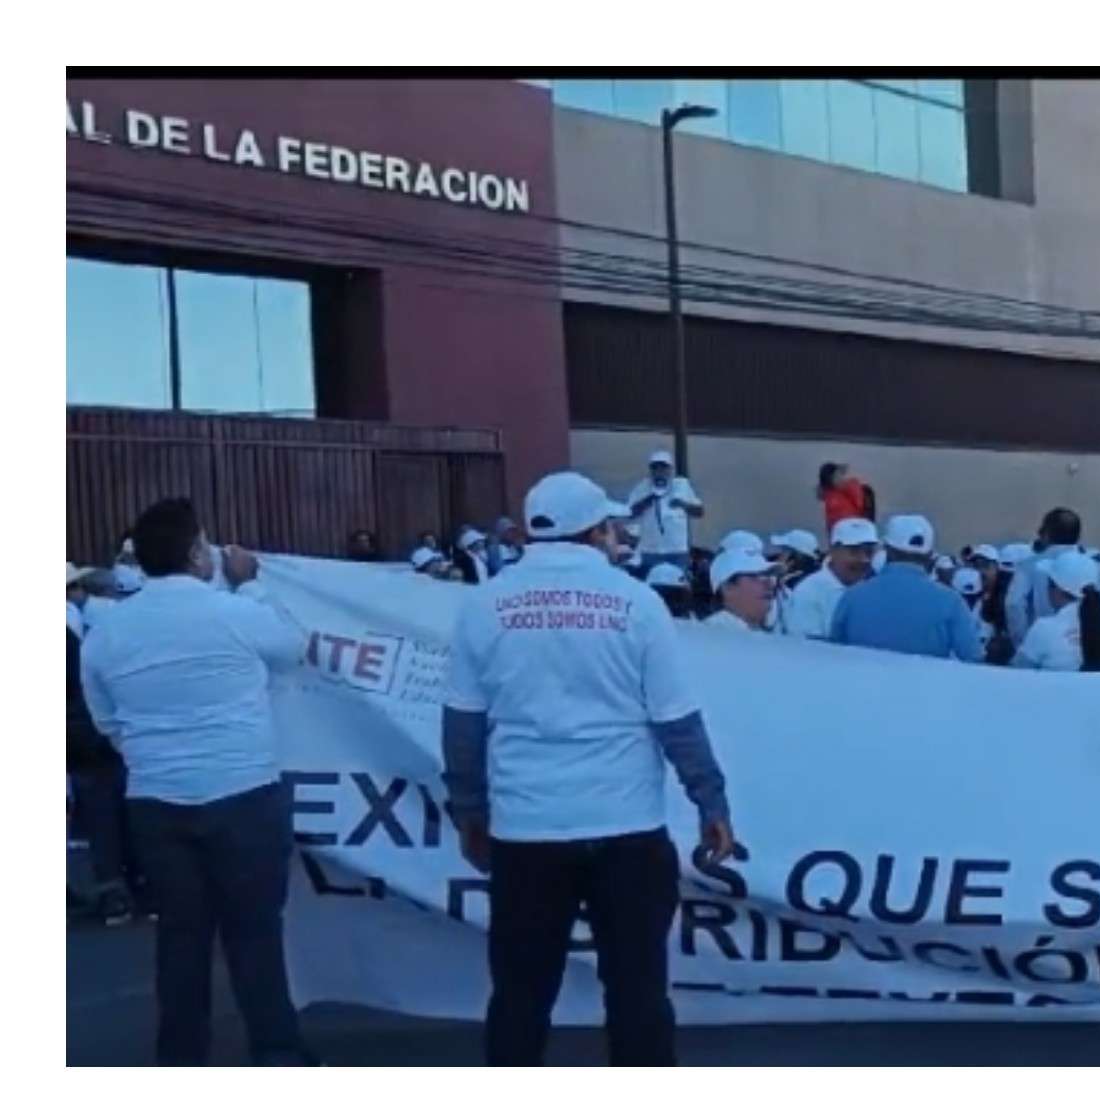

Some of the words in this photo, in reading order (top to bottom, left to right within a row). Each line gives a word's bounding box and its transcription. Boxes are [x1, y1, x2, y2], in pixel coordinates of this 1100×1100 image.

[127, 109, 190, 154] DE
[204, 124, 264, 166] LA
[278, 136, 529, 212] FEDERACION
[307, 630, 387, 682] TE
[786, 850, 1010, 926] QUE
